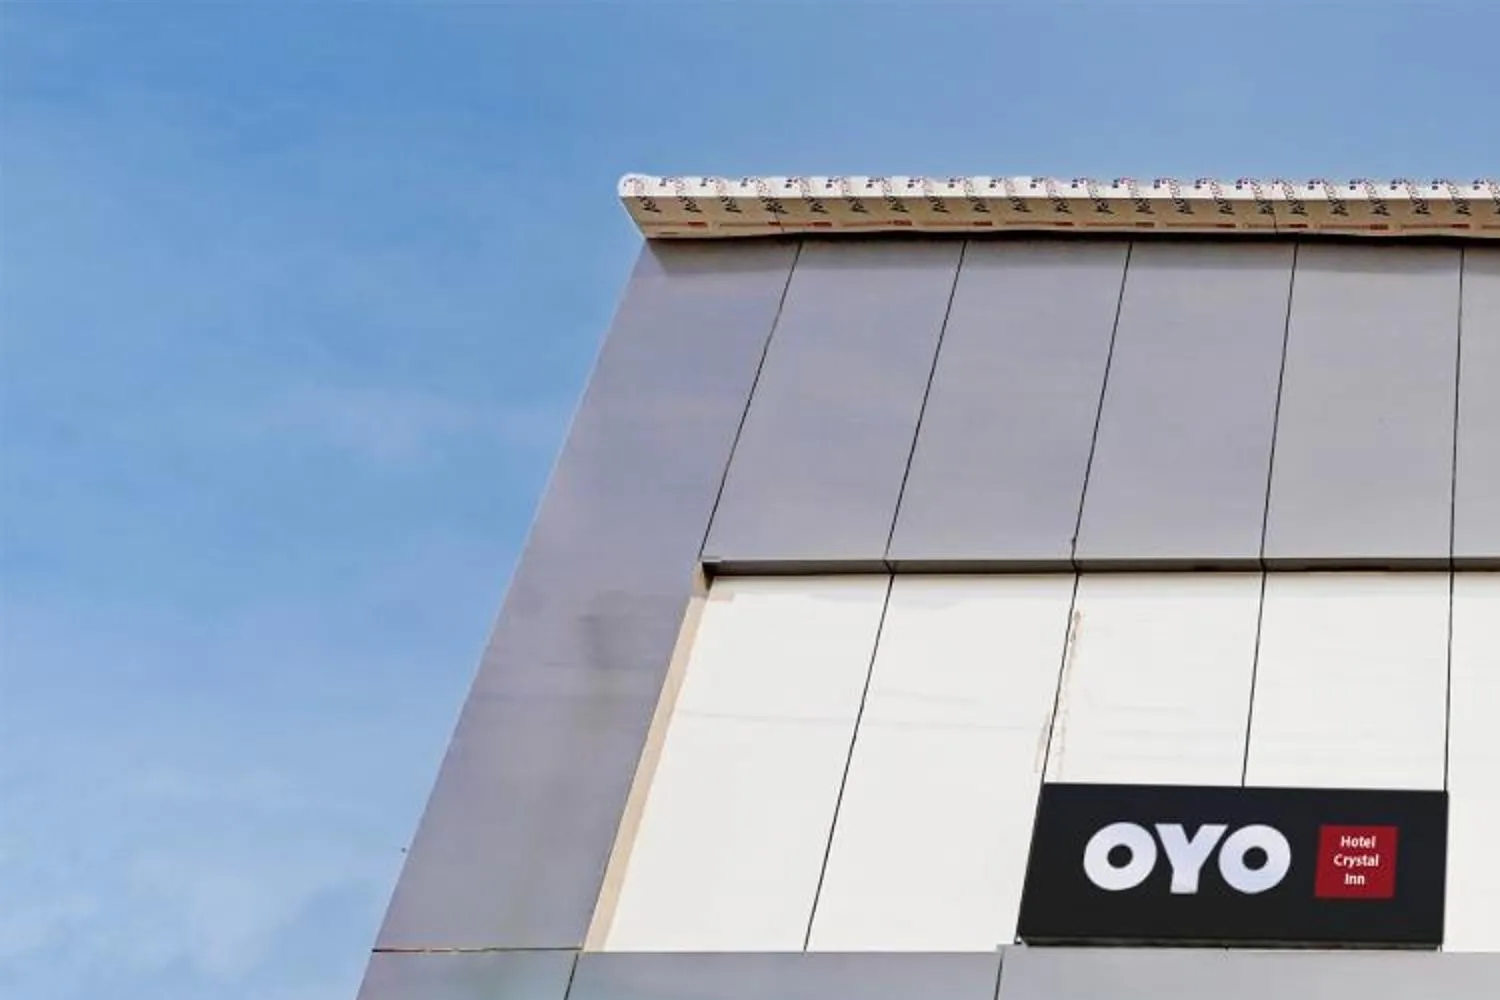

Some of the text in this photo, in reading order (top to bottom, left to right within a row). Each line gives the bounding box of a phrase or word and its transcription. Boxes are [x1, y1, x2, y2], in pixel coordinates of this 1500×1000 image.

[1340, 835, 1377, 849] Hotel
[1083, 821, 1292, 894] OYO
[1333, 853, 1380, 869] Crystal
[1344, 872, 1366, 885] Inn
